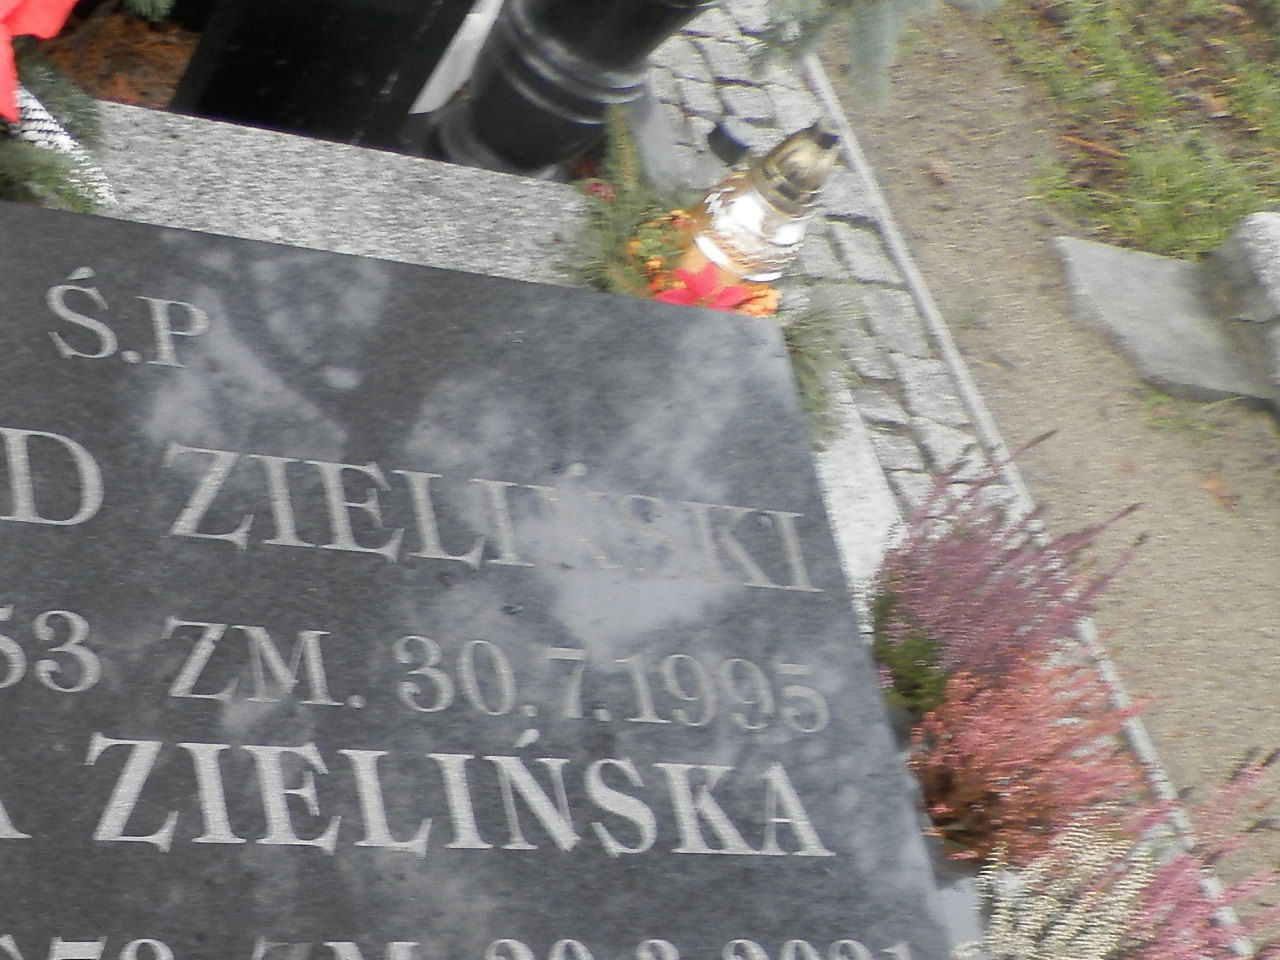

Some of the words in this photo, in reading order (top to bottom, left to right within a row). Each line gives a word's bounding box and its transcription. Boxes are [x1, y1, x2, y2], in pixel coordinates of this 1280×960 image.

[161, 614, 366, 709] ZM.
[391, 633, 831, 735] 30.7.1995
[84, 728, 837, 858] ZIELIŃSKA
